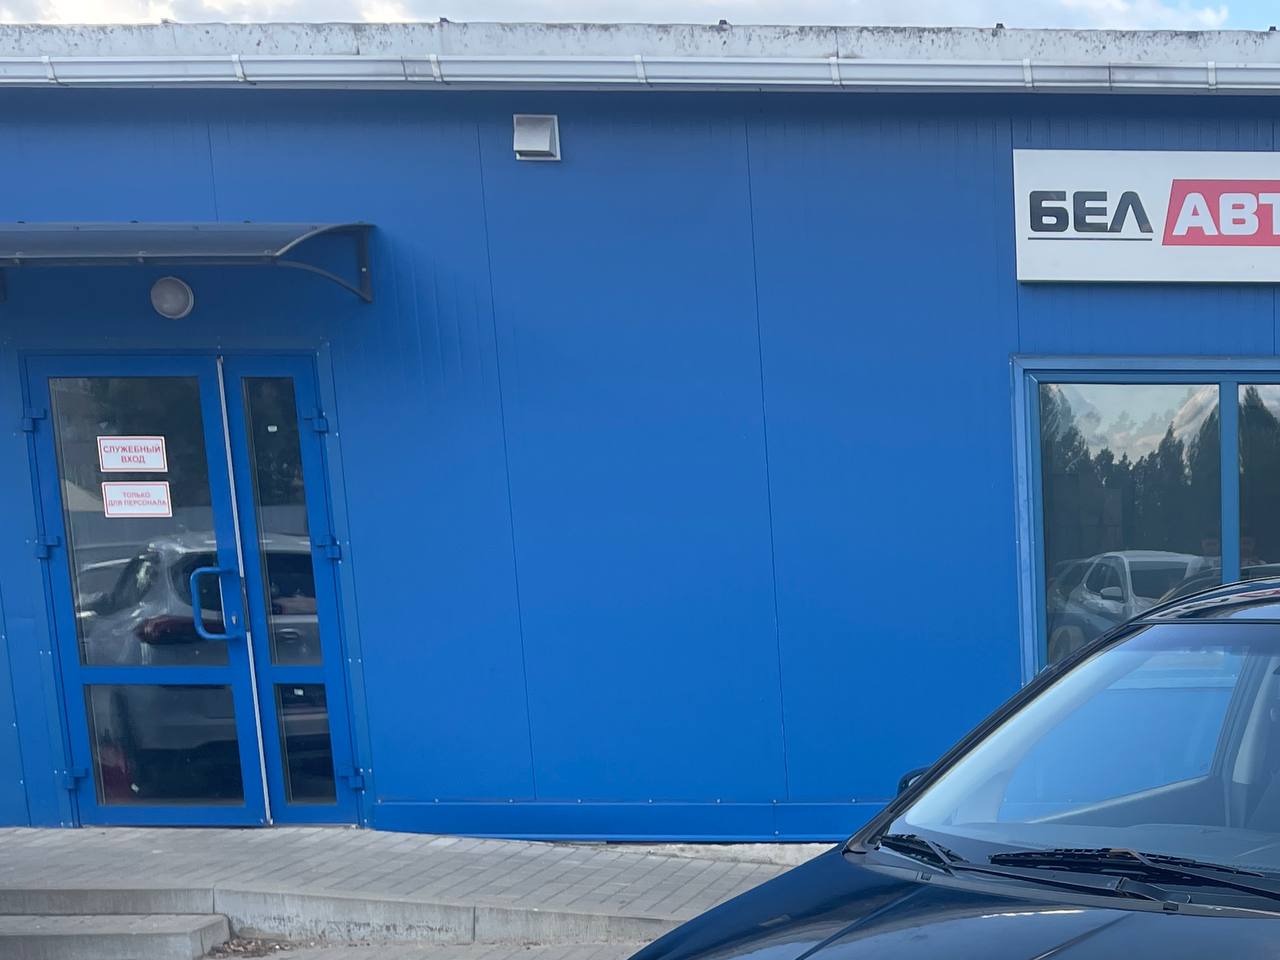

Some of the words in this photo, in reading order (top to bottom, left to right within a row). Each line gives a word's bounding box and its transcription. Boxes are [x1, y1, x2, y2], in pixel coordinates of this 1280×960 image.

[1028, 190, 1154, 233] БЕЛ
[103, 444, 161, 454] СЛУЖЕБНЫЙ
[121, 455, 146, 464] ВХОД
